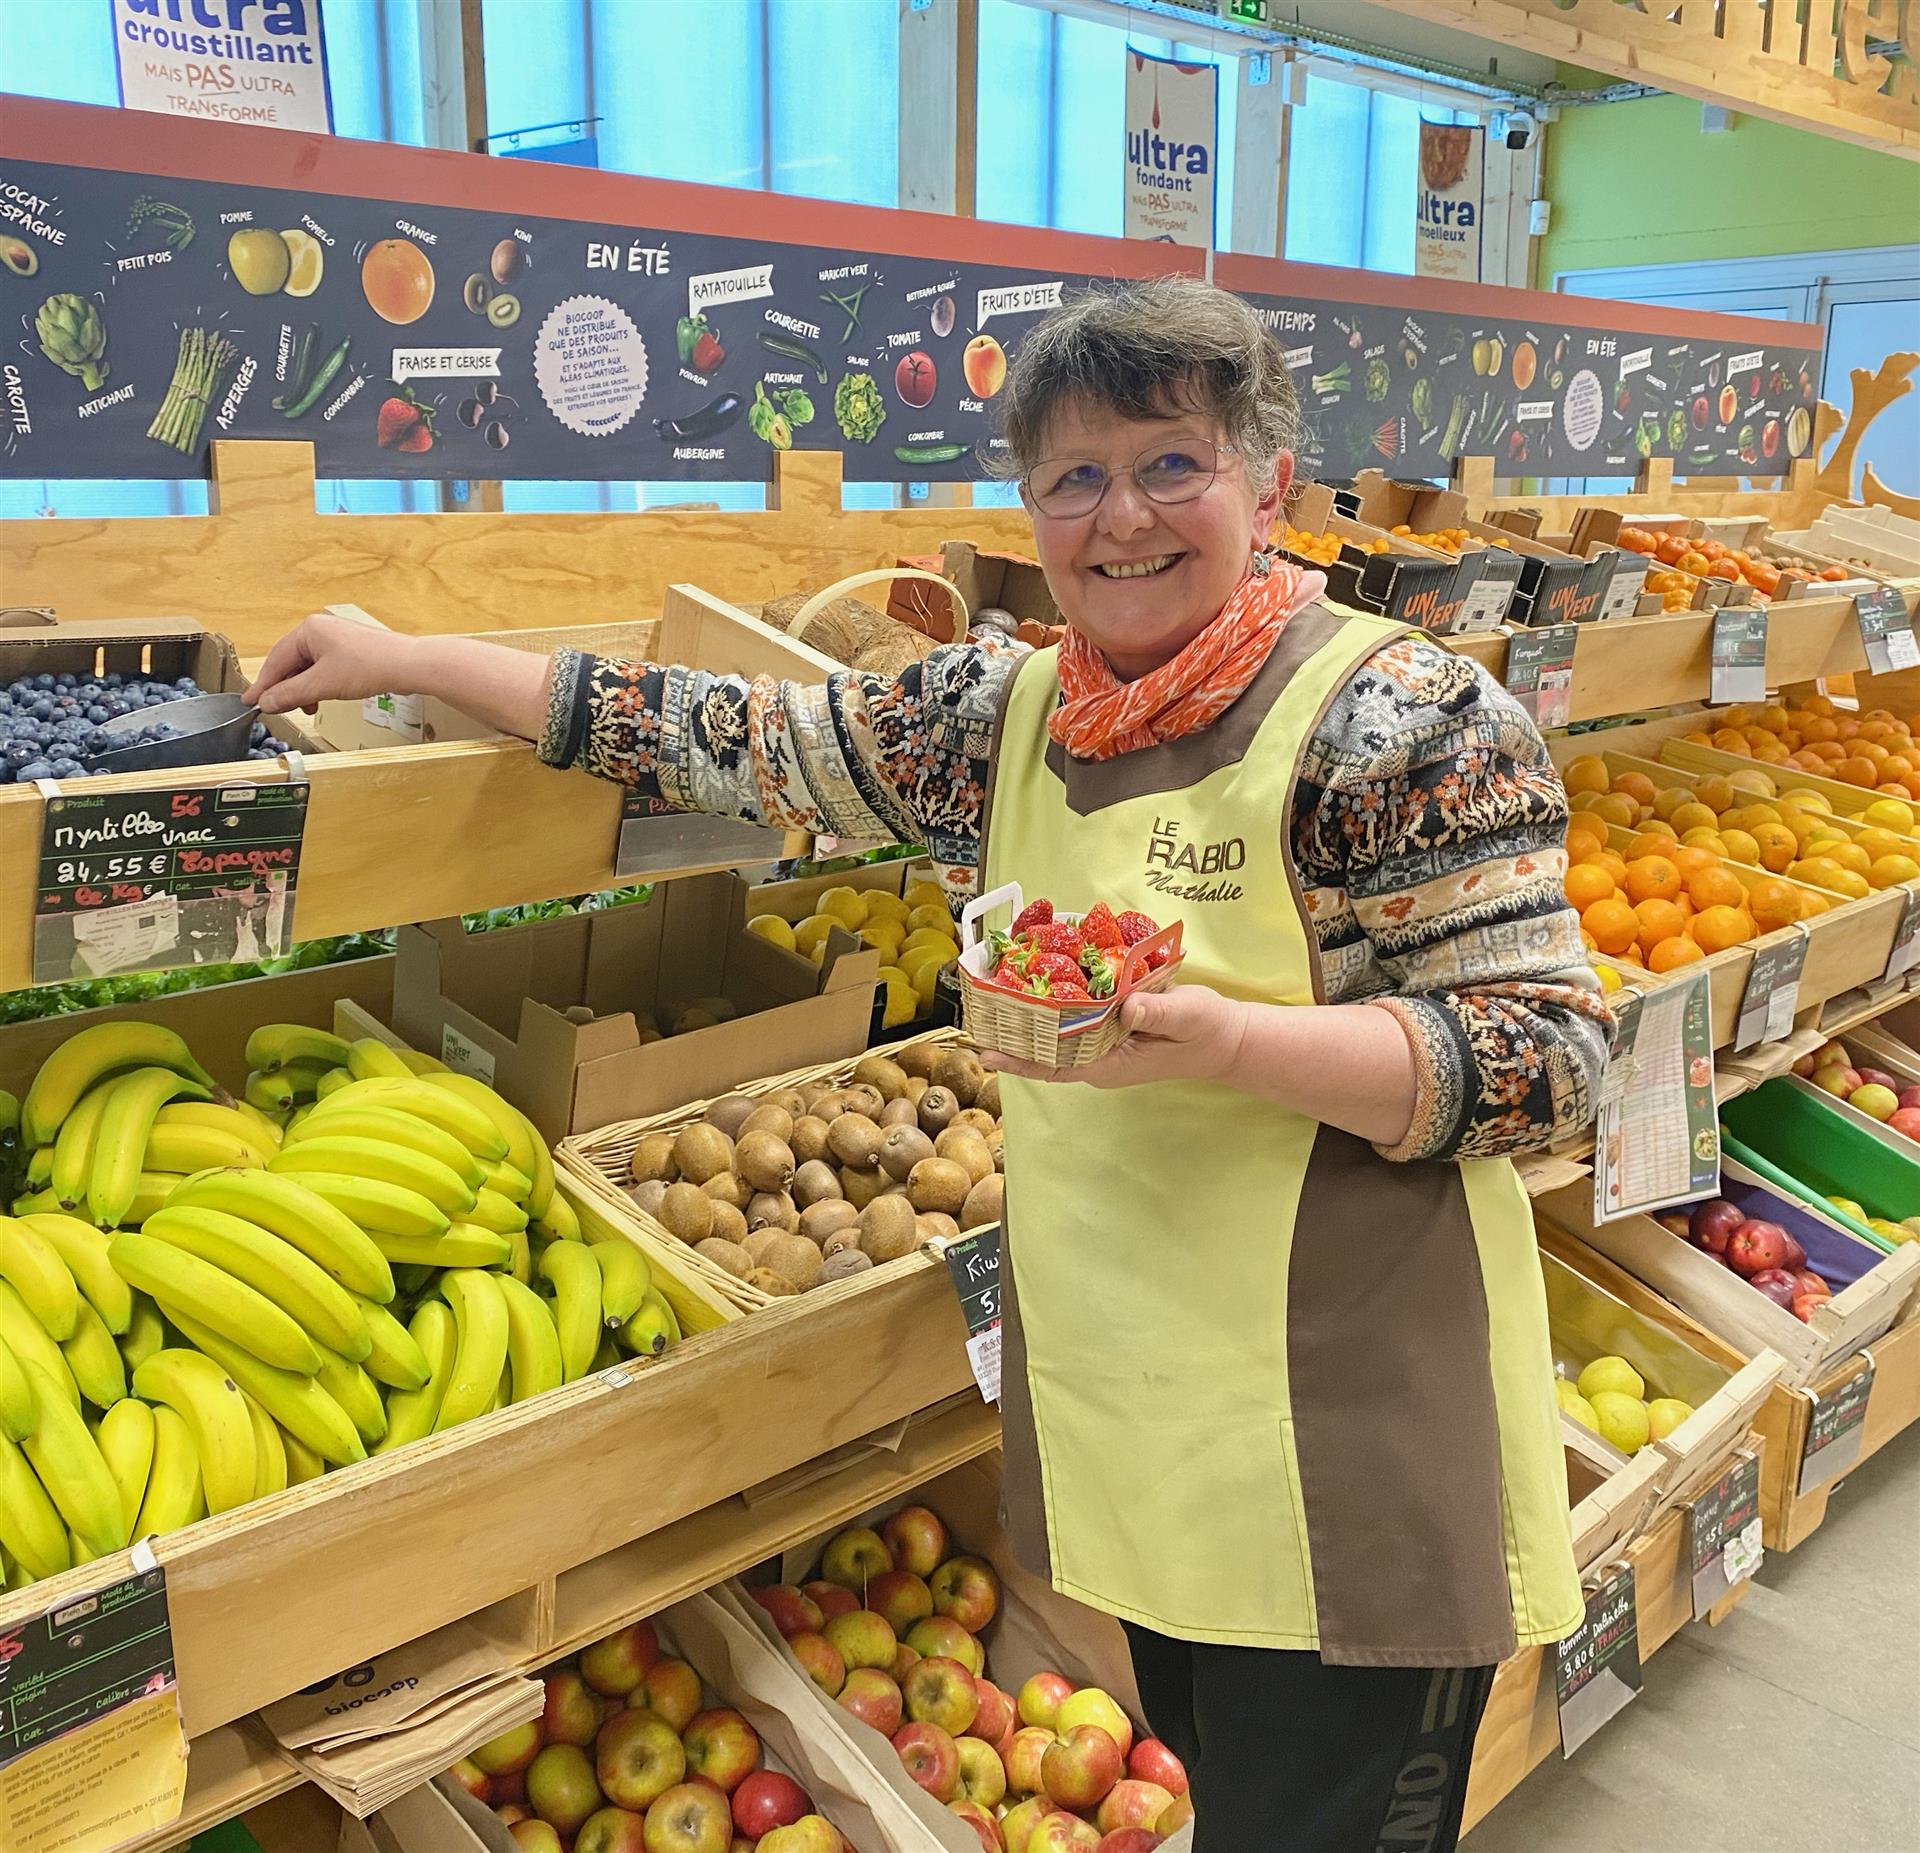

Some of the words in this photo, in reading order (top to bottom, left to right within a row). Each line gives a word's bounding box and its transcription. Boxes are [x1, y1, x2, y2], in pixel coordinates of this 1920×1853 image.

[124, 19, 313, 65] croustillant
[144, 62, 182, 82] MAIS
[186, 63, 235, 89] PAS
[241, 76, 296, 96] ULTRA
[166, 94, 278, 122] TRANSFORMÉ
[1128, 128, 1209, 175] ultra
[1136, 166, 1193, 192] fondant
[1148, 193, 1170, 211] PAS
[220, 211, 254, 225] POMME
[300, 214, 335, 247] POMELO
[395, 219, 438, 245] ORANGE
[513, 227, 533, 244] KIWI
[117, 252, 145, 272] PETIT
[148, 251, 172, 267] POIS
[587, 242, 620, 270] EN
[628, 239, 670, 276] ÉTÉ
[819, 265, 849, 281] HARICOT
[850, 263, 869, 277] VERT
[693, 275, 767, 300] RATATOUILLE
[906, 285, 937, 302] BETTERAVE
[982, 292, 1020, 312] FRUITS
[1024, 284, 1055, 306] D'ÉTÉ
[558, 327, 569, 336] NE
[572, 319, 617, 335] DISTRIBUE
[566, 310, 604, 324] BIOCOOP
[764, 308, 822, 340] COURGETTE
[549, 340, 566, 351] QUE
[568, 336, 586, 347] DES
[588, 329, 629, 344] PRODUITS
[886, 331, 921, 348] TOMATE
[1586, 339, 1600, 355] EN
[275, 324, 292, 382] COURGETTE
[399, 356, 437, 370] FRAISE
[440, 356, 453, 370] ET
[456, 355, 492, 370] CERISE
[562, 350, 574, 360] DE
[562, 364, 570, 373] ET
[573, 358, 606, 372] S'ADAPTE
[607, 356, 621, 365] AUX
[847, 355, 869, 366] SALADE
[678, 367, 709, 387] POIVRON
[764, 372, 804, 384] ARTICHAUT
[3, 364, 32, 435] CAROTTE
[78, 384, 136, 419] ARTICHAUT
[215, 356, 258, 430] ASPERGES
[323, 375, 366, 421] CONCOMBRE
[908, 430, 945, 442] CONCOMBRE
[673, 447, 725, 461] AUBERGINE
[1563, 592, 1600, 622] VERT
[67, 798, 104, 809] Produit
[1152, 816, 1180, 837] LE
[1146, 837, 1245, 874] RABIO
[1145, 869, 1244, 902] Nathalie
[966, 1248, 1000, 1283] Kiw
[124, 1582, 134, 1592] de
[1559, 1624, 1588, 1658] Pomme
[325, 1676, 419, 1716] biocoop
